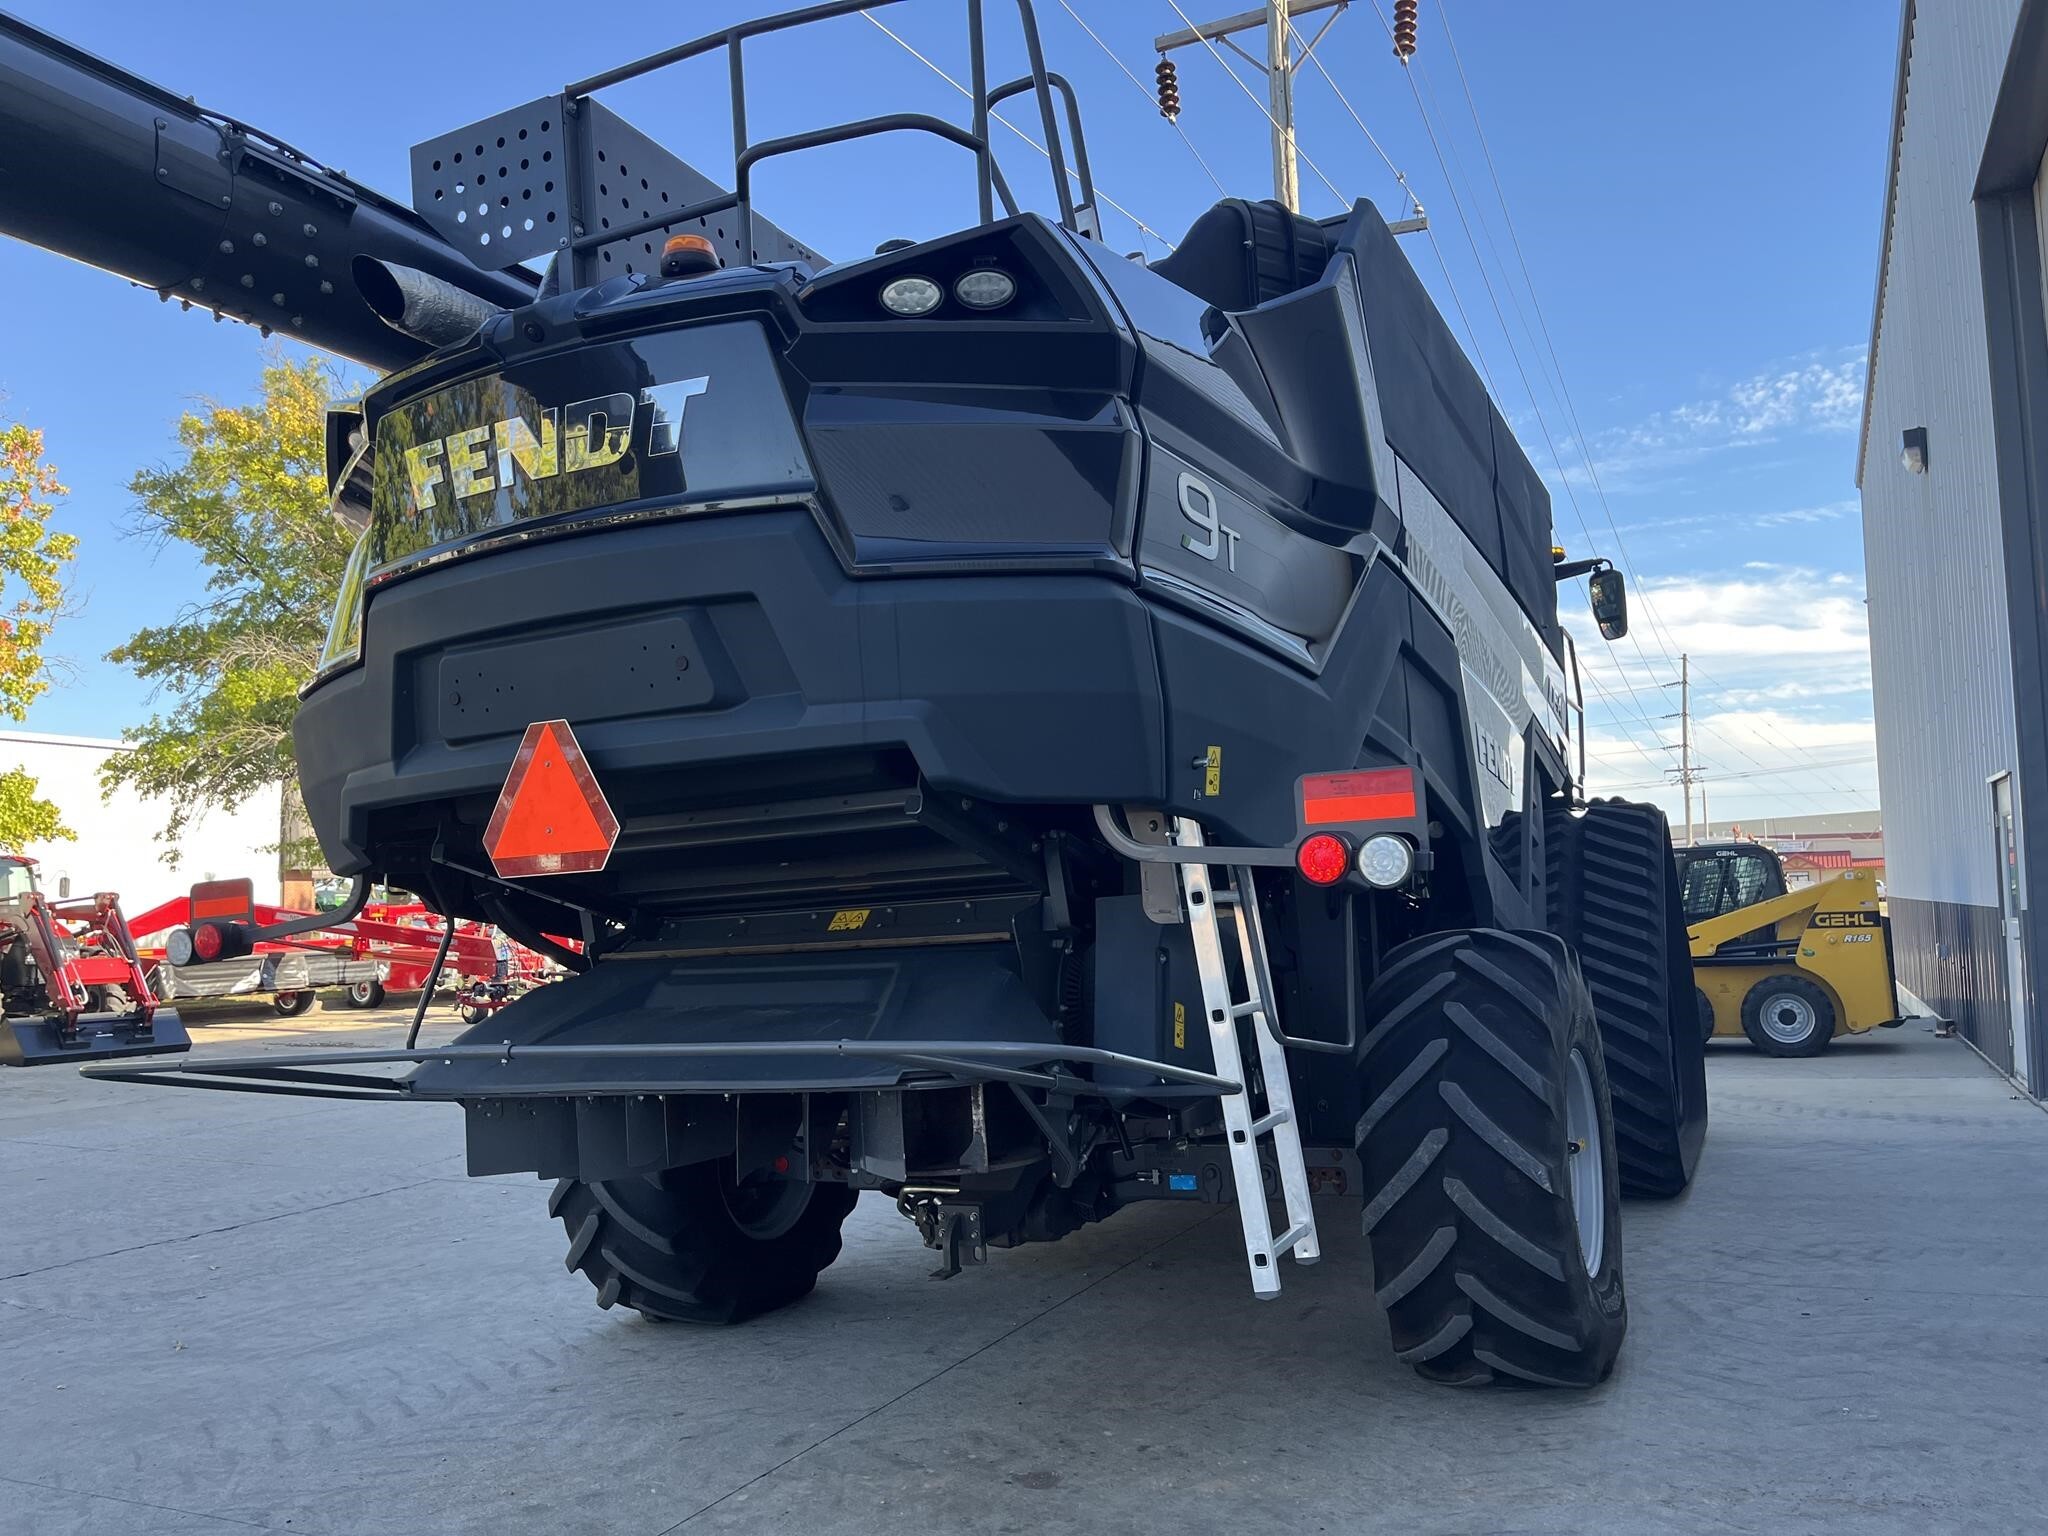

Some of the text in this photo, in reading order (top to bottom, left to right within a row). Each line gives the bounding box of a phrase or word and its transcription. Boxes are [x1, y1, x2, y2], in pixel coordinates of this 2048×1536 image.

[404, 375, 710, 511] FENDT
[1814, 913, 1874, 927] GEHL
[1843, 934, 1873, 944] R165
